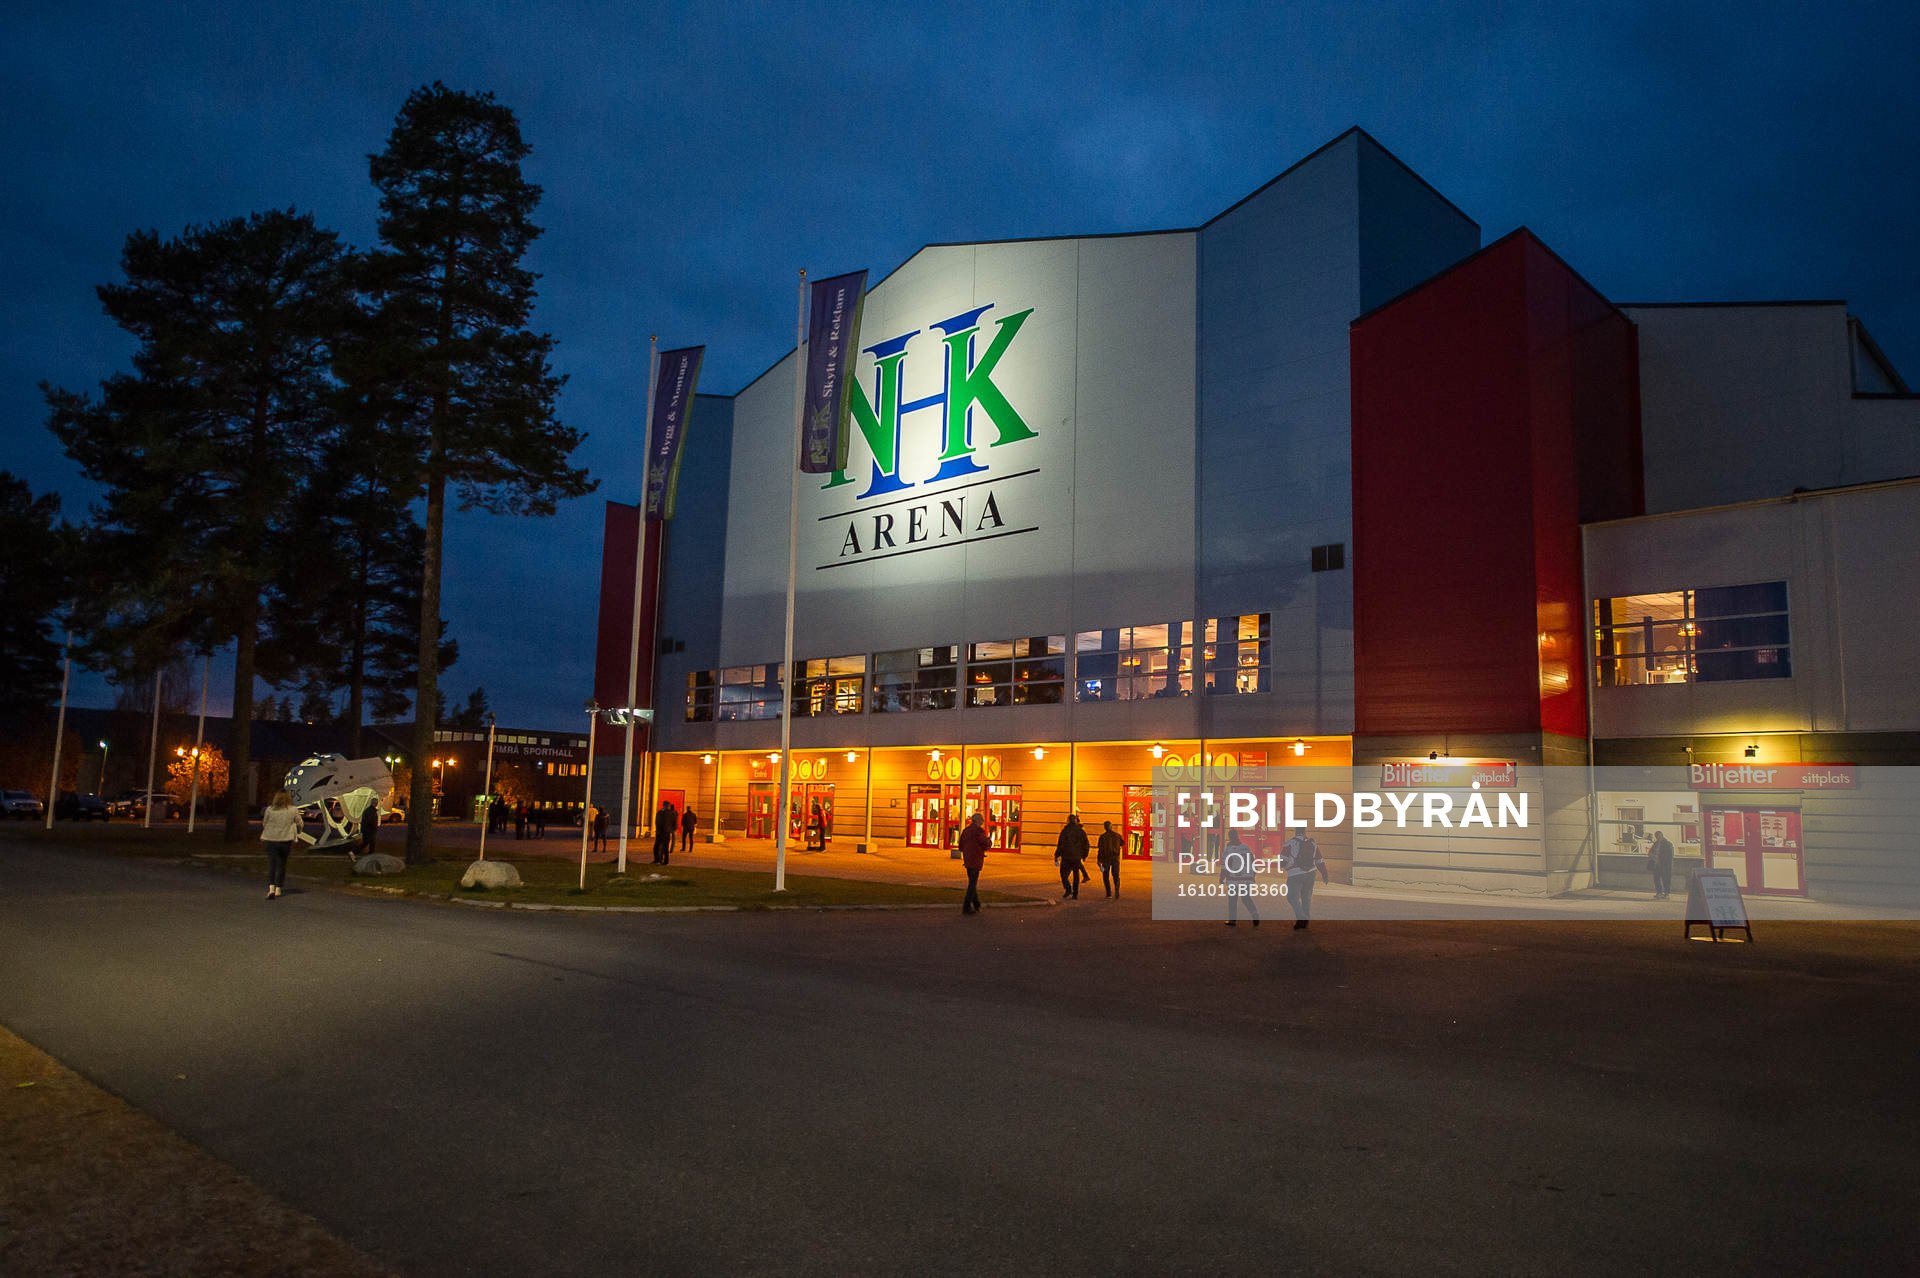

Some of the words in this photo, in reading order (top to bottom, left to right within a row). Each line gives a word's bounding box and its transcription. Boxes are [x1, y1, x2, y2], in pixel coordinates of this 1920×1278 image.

[830, 288, 845, 341] Reklam
[828, 345, 838, 359] &
[823, 362, 836, 399] Skylt
[821, 303, 1039, 500] NHK
[839, 490, 1005, 557] ARENA
[493, 744, 519, 754] IMRÅ
[523, 746, 574, 758] SPORTHALL
[1384, 764, 1450, 787] Biljetter
[1472, 771, 1510, 785] sittplats
[1691, 763, 1777, 788] Biljetter
[1801, 771, 1850, 787] sittplats
